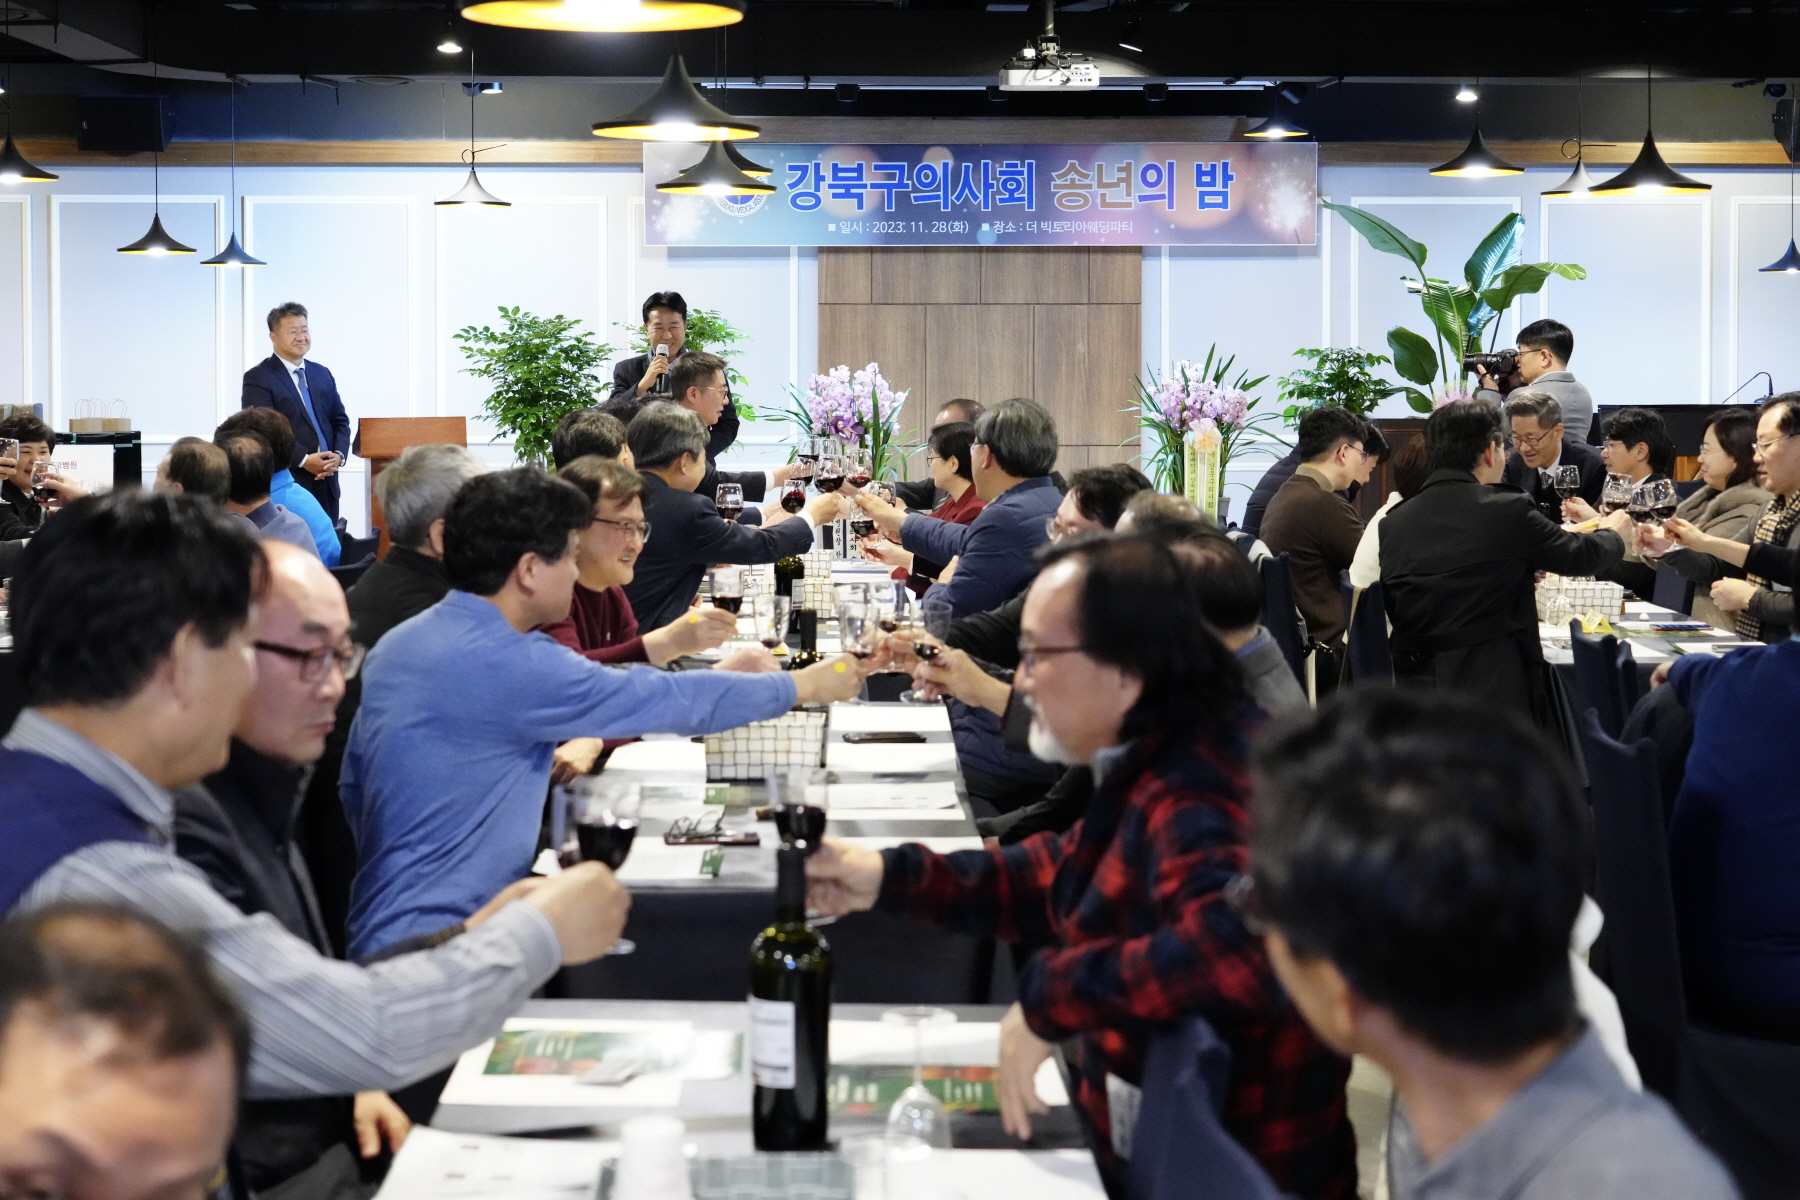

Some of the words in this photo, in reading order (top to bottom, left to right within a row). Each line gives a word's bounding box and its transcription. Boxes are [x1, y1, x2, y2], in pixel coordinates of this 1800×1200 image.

[785, 160, 1036, 211] 강북구의사회
[1051, 160, 1176, 211] 송년의
[1194, 160, 1235, 211] 밤
[839, 221, 862, 234] 일시
[872, 221, 906, 233] 2023.
[910, 221, 928, 233] 11.
[931, 221, 969, 234] 28(화)
[993, 221, 1017, 234] 장소
[1026, 221, 1037, 234] 더
[1040, 221, 1133, 233] 빅토리아웨딩파티
